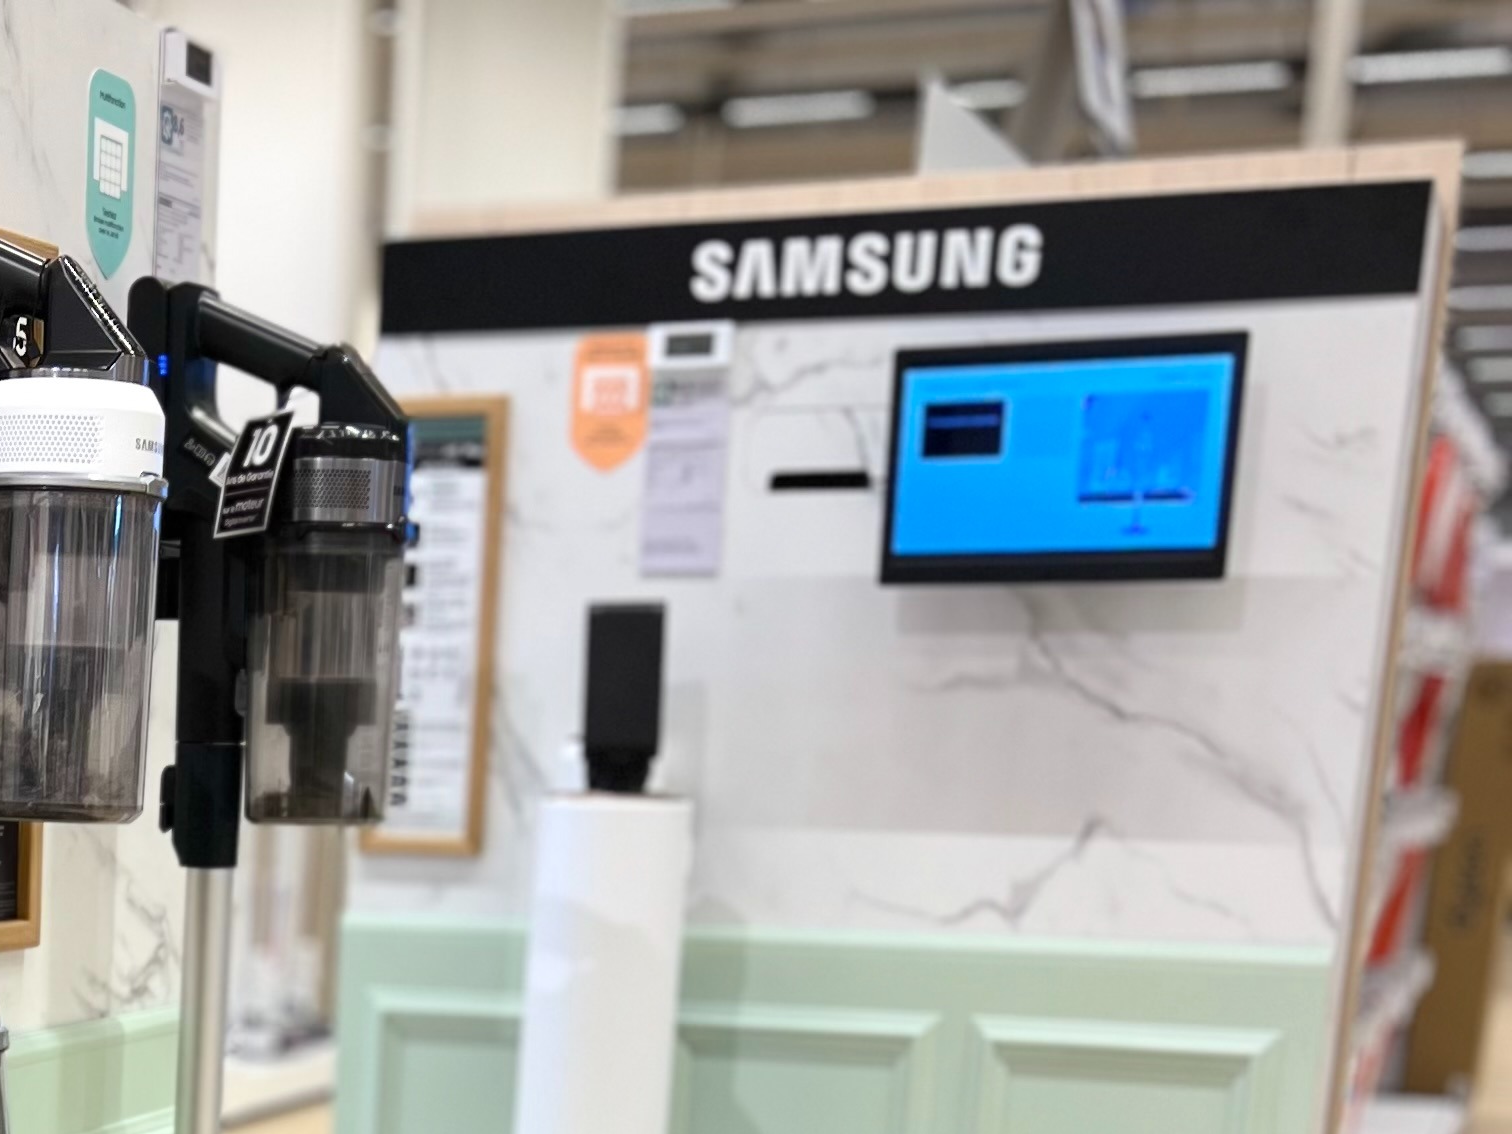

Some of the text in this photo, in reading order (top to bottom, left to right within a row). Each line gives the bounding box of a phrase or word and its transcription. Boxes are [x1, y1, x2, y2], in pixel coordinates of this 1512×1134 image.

[689, 224, 1044, 302] SAMSUNG
[13, 317, 28, 357] 5
[135, 437, 164, 456] SAMS
[243, 424, 279, 468] 10
